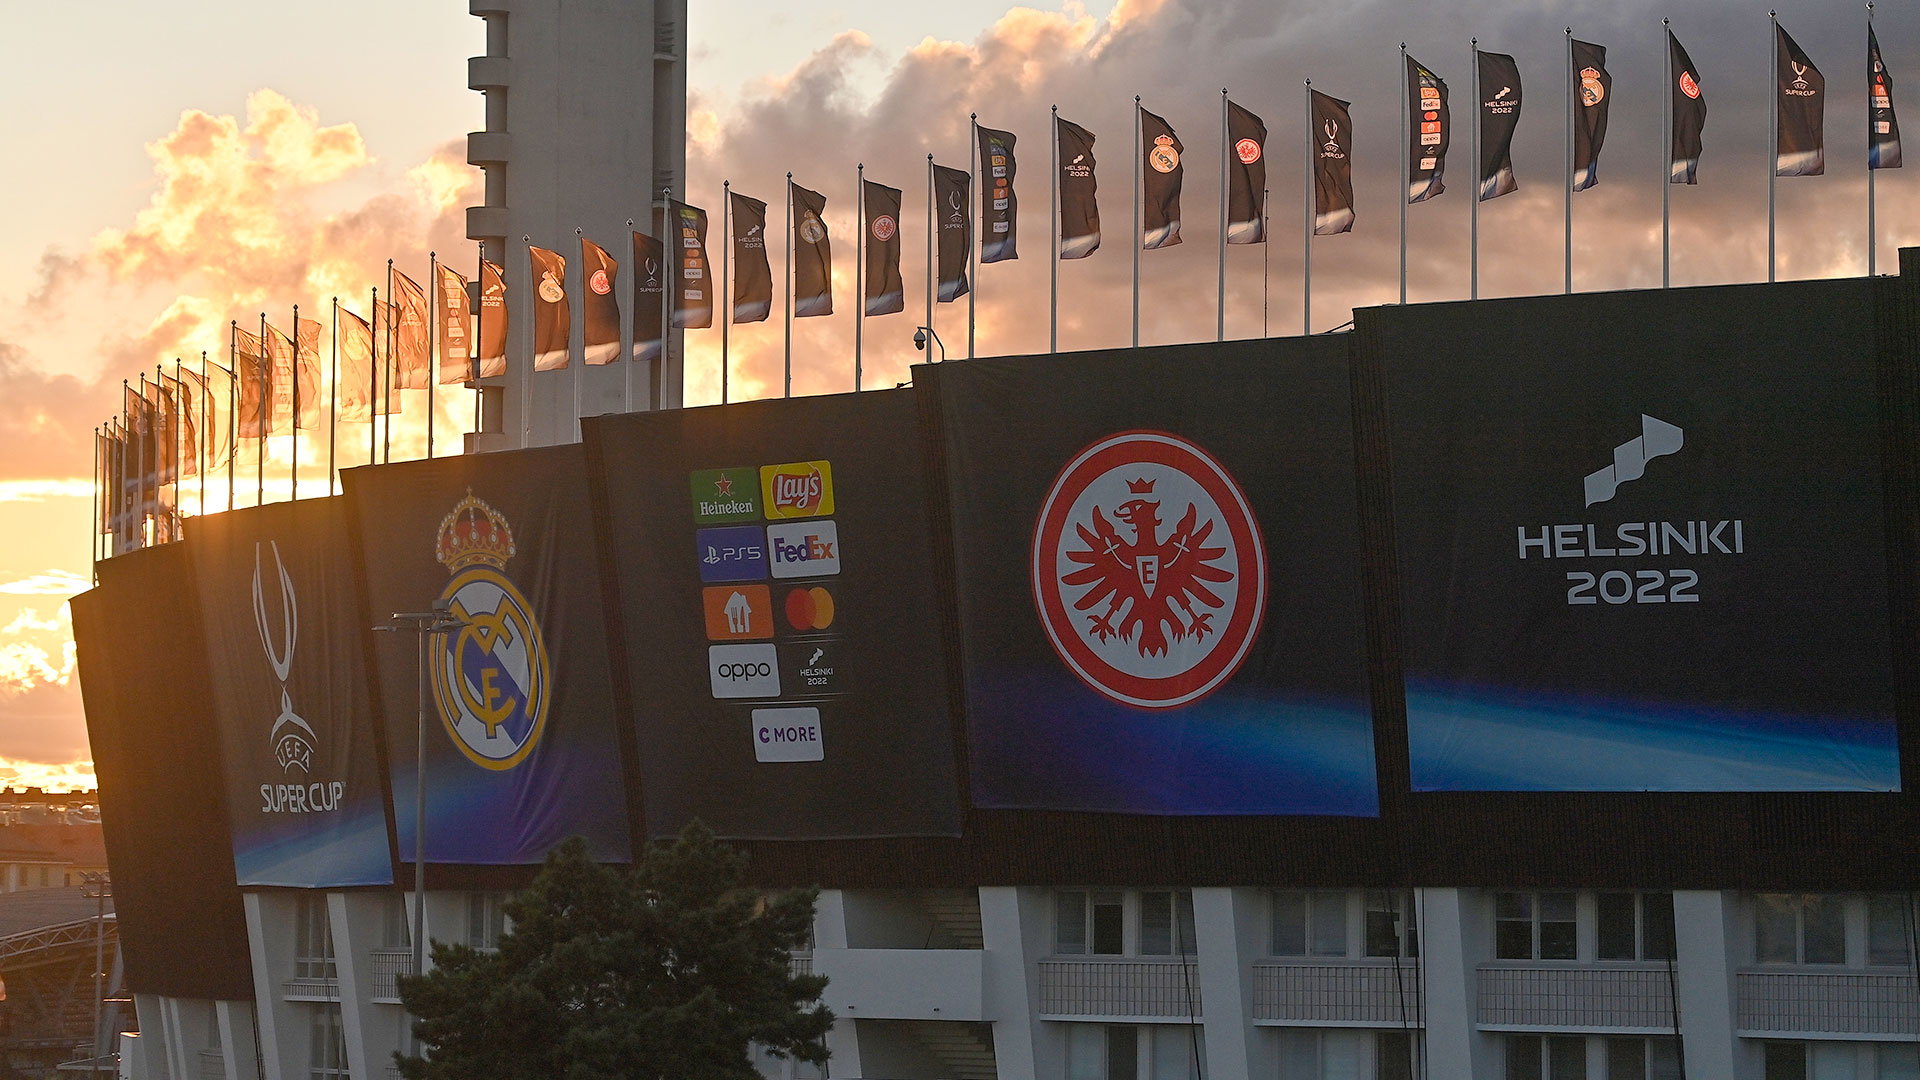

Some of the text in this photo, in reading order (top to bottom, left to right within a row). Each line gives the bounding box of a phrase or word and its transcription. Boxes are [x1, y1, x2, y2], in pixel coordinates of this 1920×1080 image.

[776, 472, 819, 509] Lay's
[699, 500, 753, 516] Heineken
[773, 535, 835, 563] FedEx
[1517, 519, 1744, 559] HELSINKI
[722, 546, 761, 561] PS5
[1566, 569, 1700, 605] 2022
[718, 662, 771, 681] oppo
[800, 668, 834, 677] HELSINKI
[807, 677, 828, 685] 2022
[759, 726, 817, 743] C MORE
[277, 740, 310, 768] UEFA
[260, 781, 343, 813] SUPER CUP
